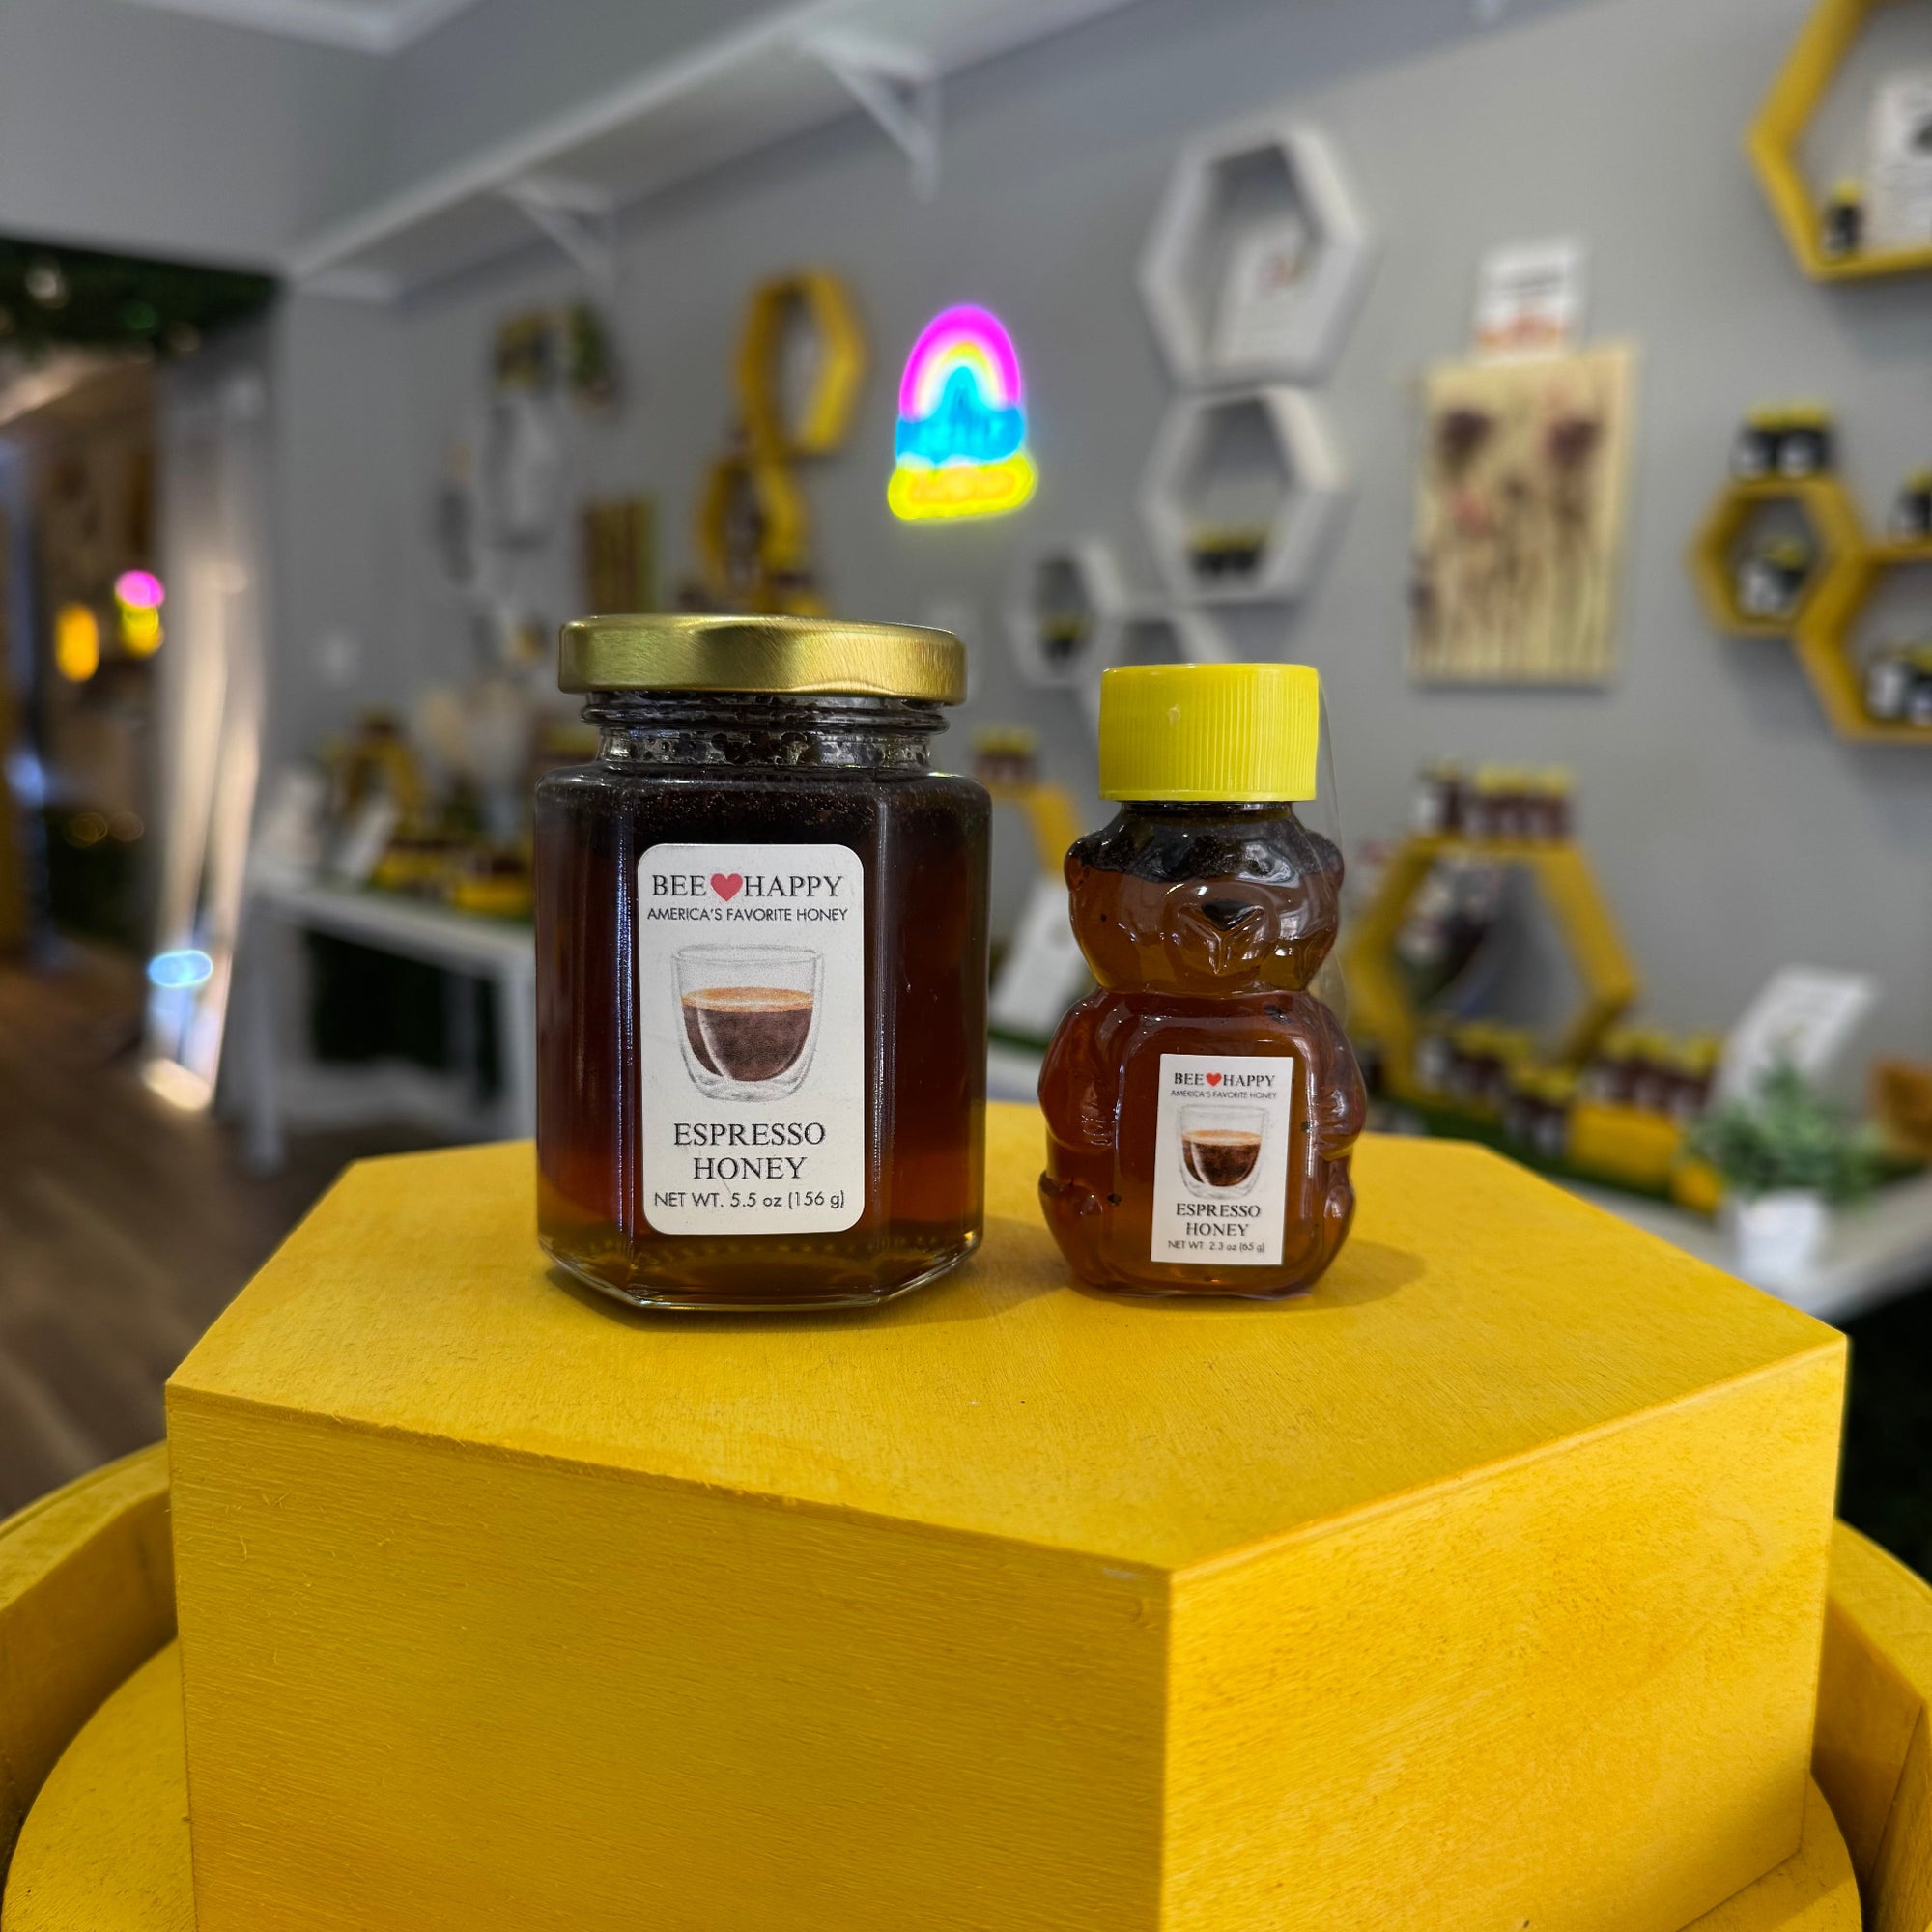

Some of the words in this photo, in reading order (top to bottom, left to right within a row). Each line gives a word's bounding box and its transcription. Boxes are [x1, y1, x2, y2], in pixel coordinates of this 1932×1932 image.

[652, 874, 707, 896] BEE
[744, 875, 844, 896] HAPPY
[647, 908, 722, 921] AMERICA'S
[726, 908, 792, 921] FAVORITE
[797, 909, 848, 921] HONEY
[1174, 1073, 1204, 1085] BEE
[1223, 1074, 1275, 1087] HAPPY
[1171, 1090, 1211, 1098] AMERICA'S
[673, 1122, 825, 1146] ESPRESSO
[694, 1157, 808, 1179] HONEY
[654, 1192, 686, 1207] NET
[692, 1192, 724, 1207] WT.
[730, 1193, 756, 1208] 5.5
[763, 1197, 781, 1207] oz
[788, 1192, 825, 1209] (156
[831, 1190, 845, 1208] g)
[1177, 1203, 1261, 1217] ESPRESSO
[1186, 1222, 1249, 1236] HONEY
[1168, 1240, 1185, 1249] NET
